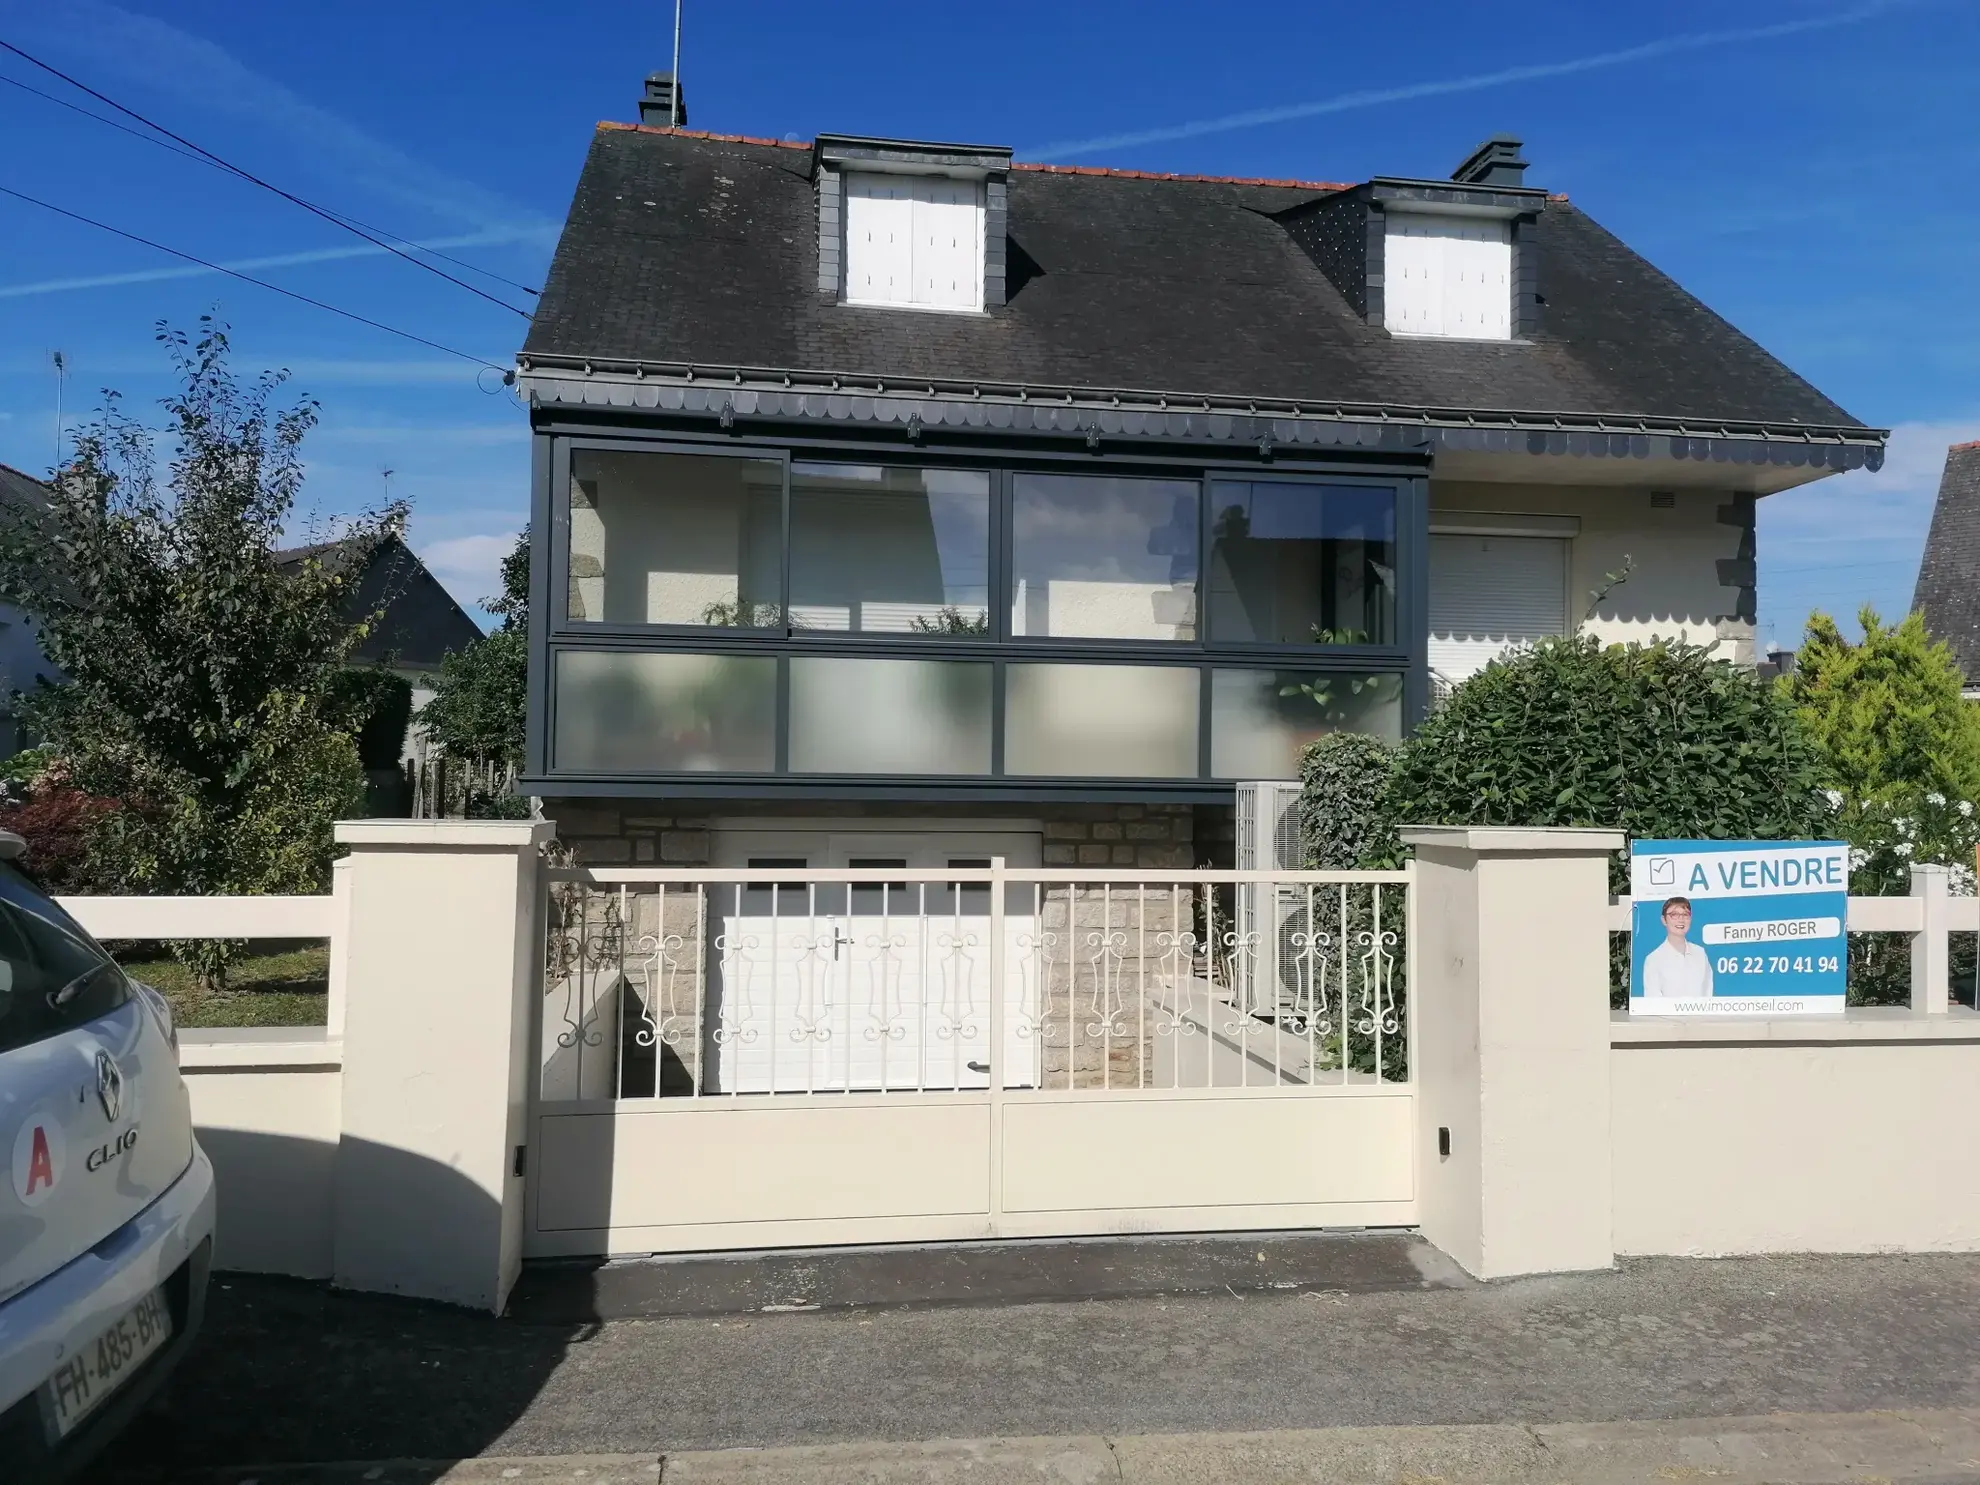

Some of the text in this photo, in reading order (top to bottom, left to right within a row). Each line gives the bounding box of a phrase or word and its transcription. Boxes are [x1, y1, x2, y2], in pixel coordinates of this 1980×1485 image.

[1689, 856, 1842, 891] A VENDRE
[1724, 921, 1817, 940] Fanny ROGER
[1717, 956, 1838, 973] 06 22 70 41 94
[1674, 998, 1804, 1012] www.imoconseil.com
[26, 1125, 53, 1195] A
[86, 1128, 137, 1172] CLIO
